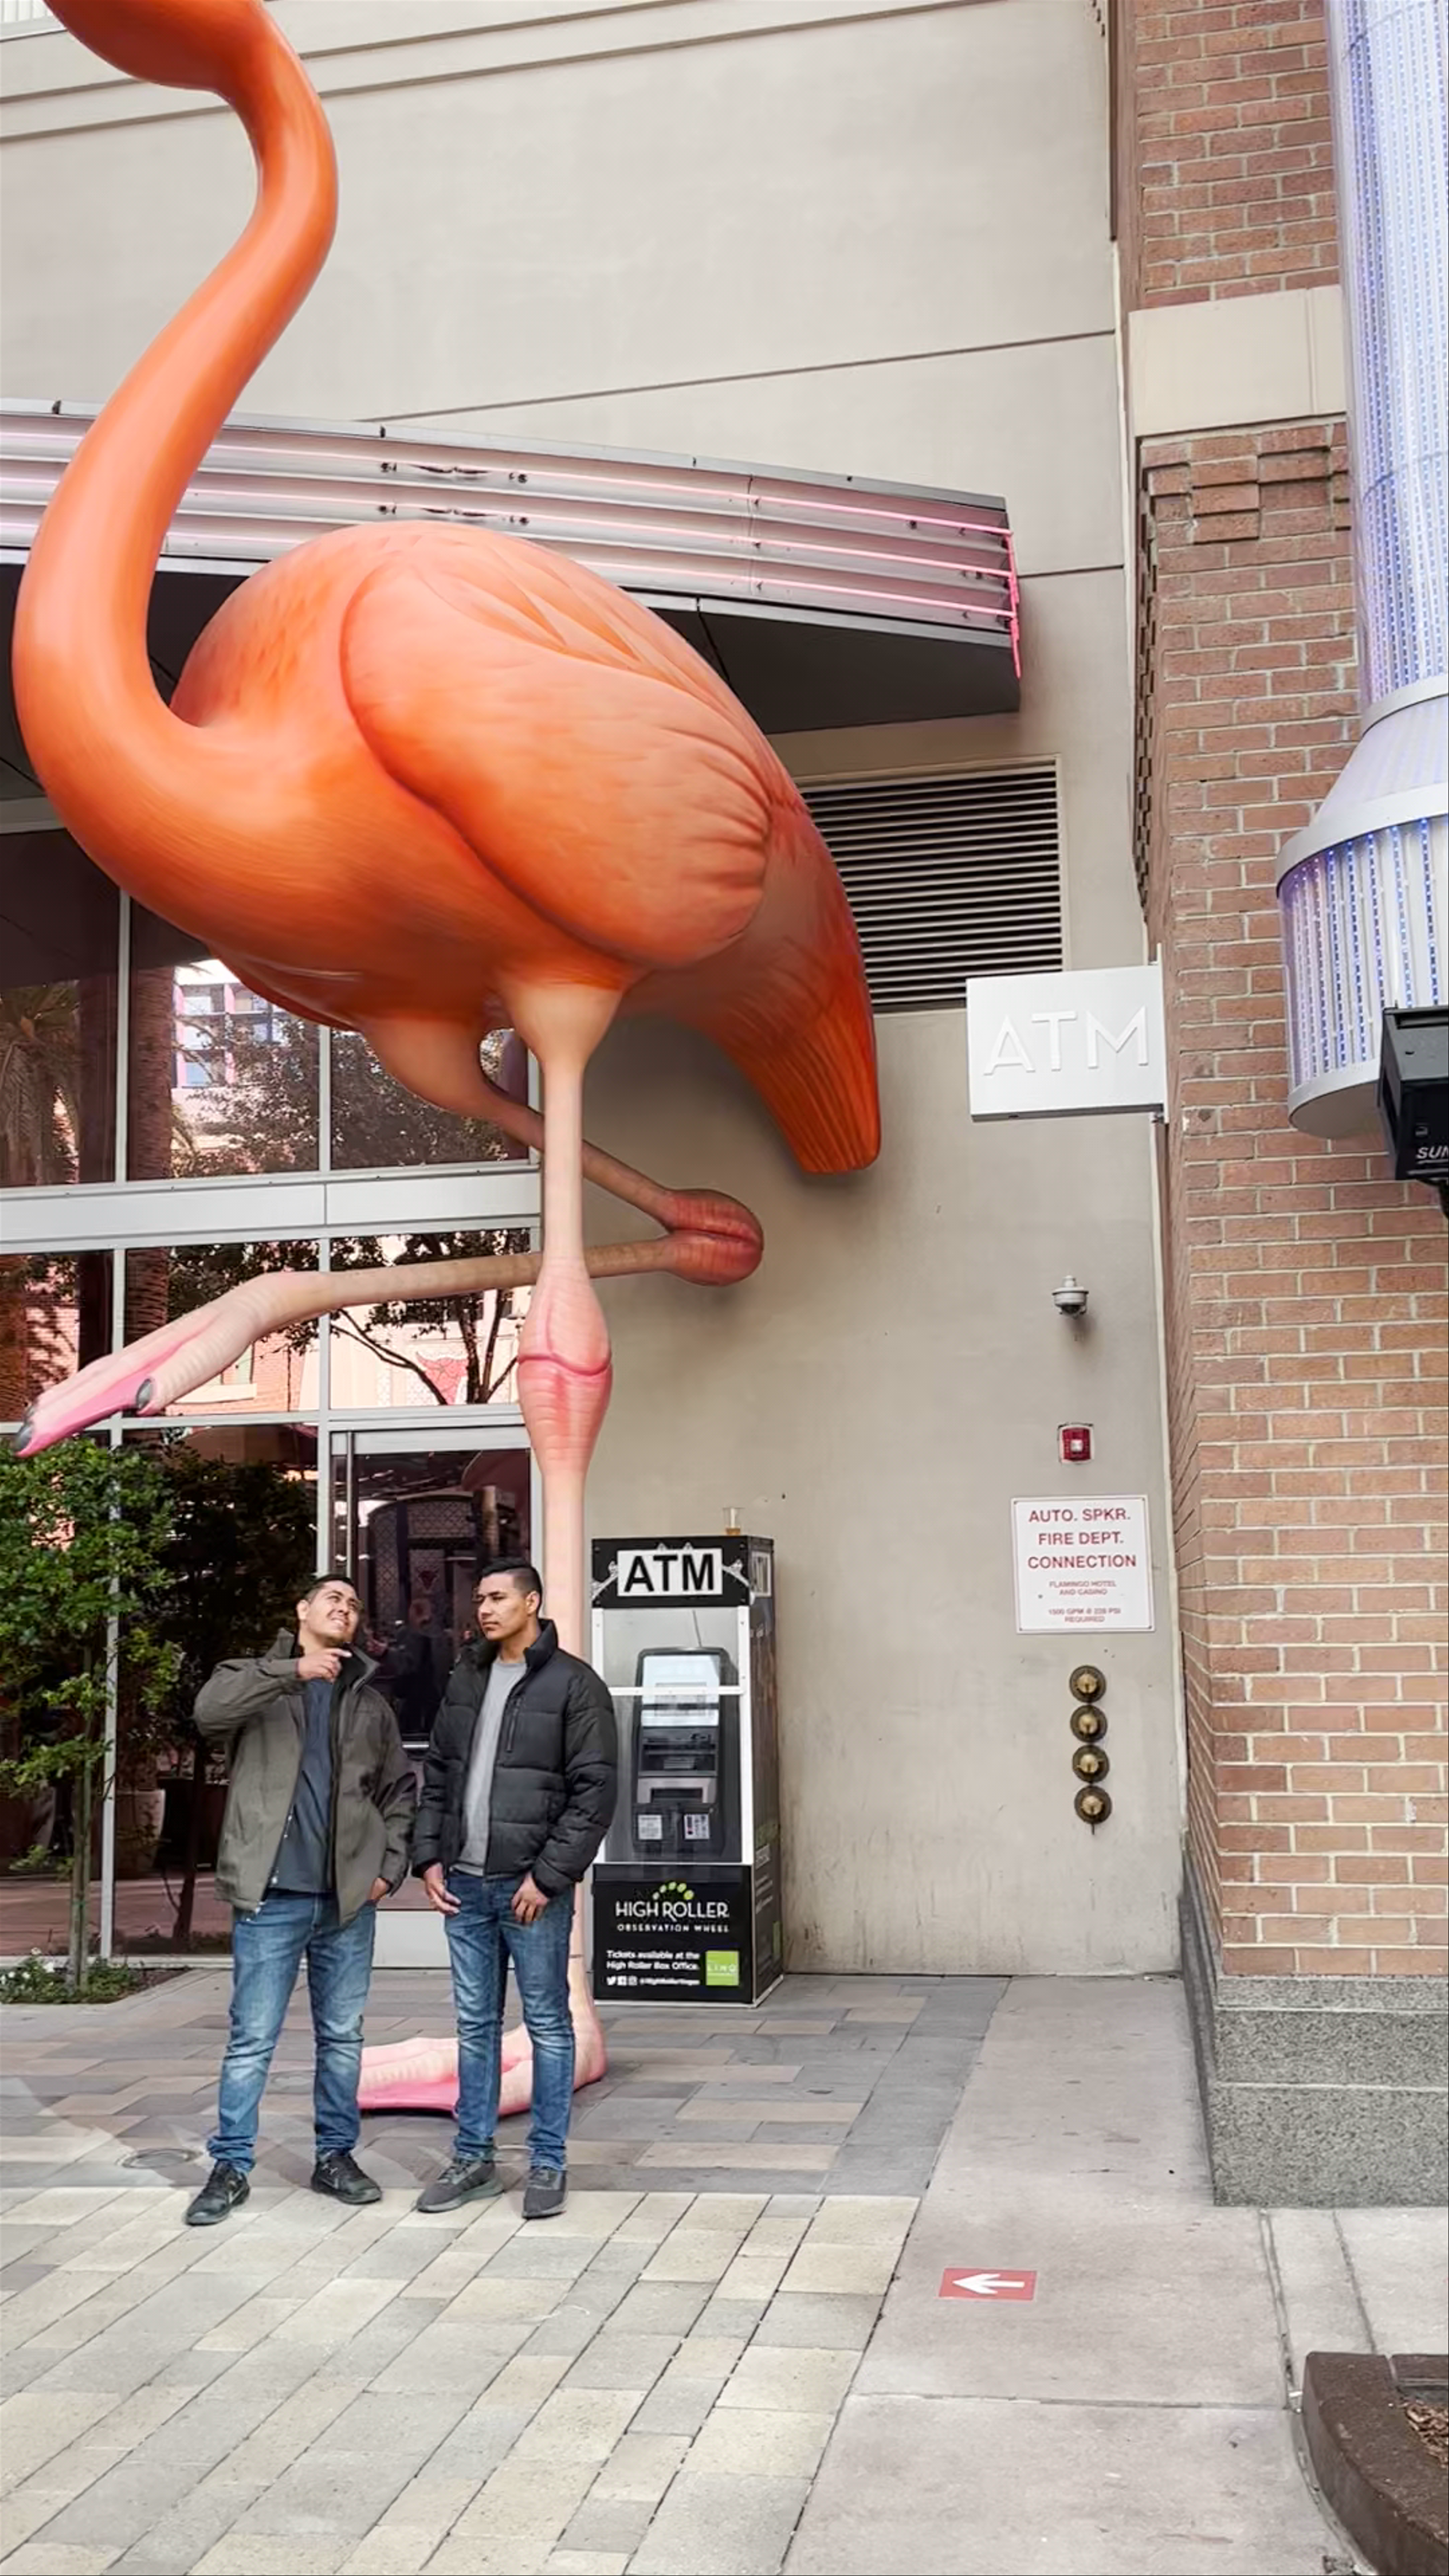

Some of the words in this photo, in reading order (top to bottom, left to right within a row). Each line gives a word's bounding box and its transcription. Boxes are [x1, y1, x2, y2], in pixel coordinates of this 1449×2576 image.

[983, 1004, 1148, 1075] ATM
[1029, 1510, 1078, 1522] AUTO.
[1082, 1508, 1131, 1521] SPKR.
[1038, 1533, 1074, 1545] FIRE
[1079, 1531, 1124, 1544] DEPT.
[1028, 1555, 1137, 1569] CONNECTION
[625, 1553, 714, 1593] ATM
[615, 1901, 659, 1917] HIGH
[662, 1901, 729, 1922] ROLLER
[606, 1950, 635, 1959] Tickets
[638, 1951, 674, 1959] available
[606, 1961, 626, 1971] High
[628, 1961, 652, 1970] Roller
[654, 1961, 671, 1970] Box
